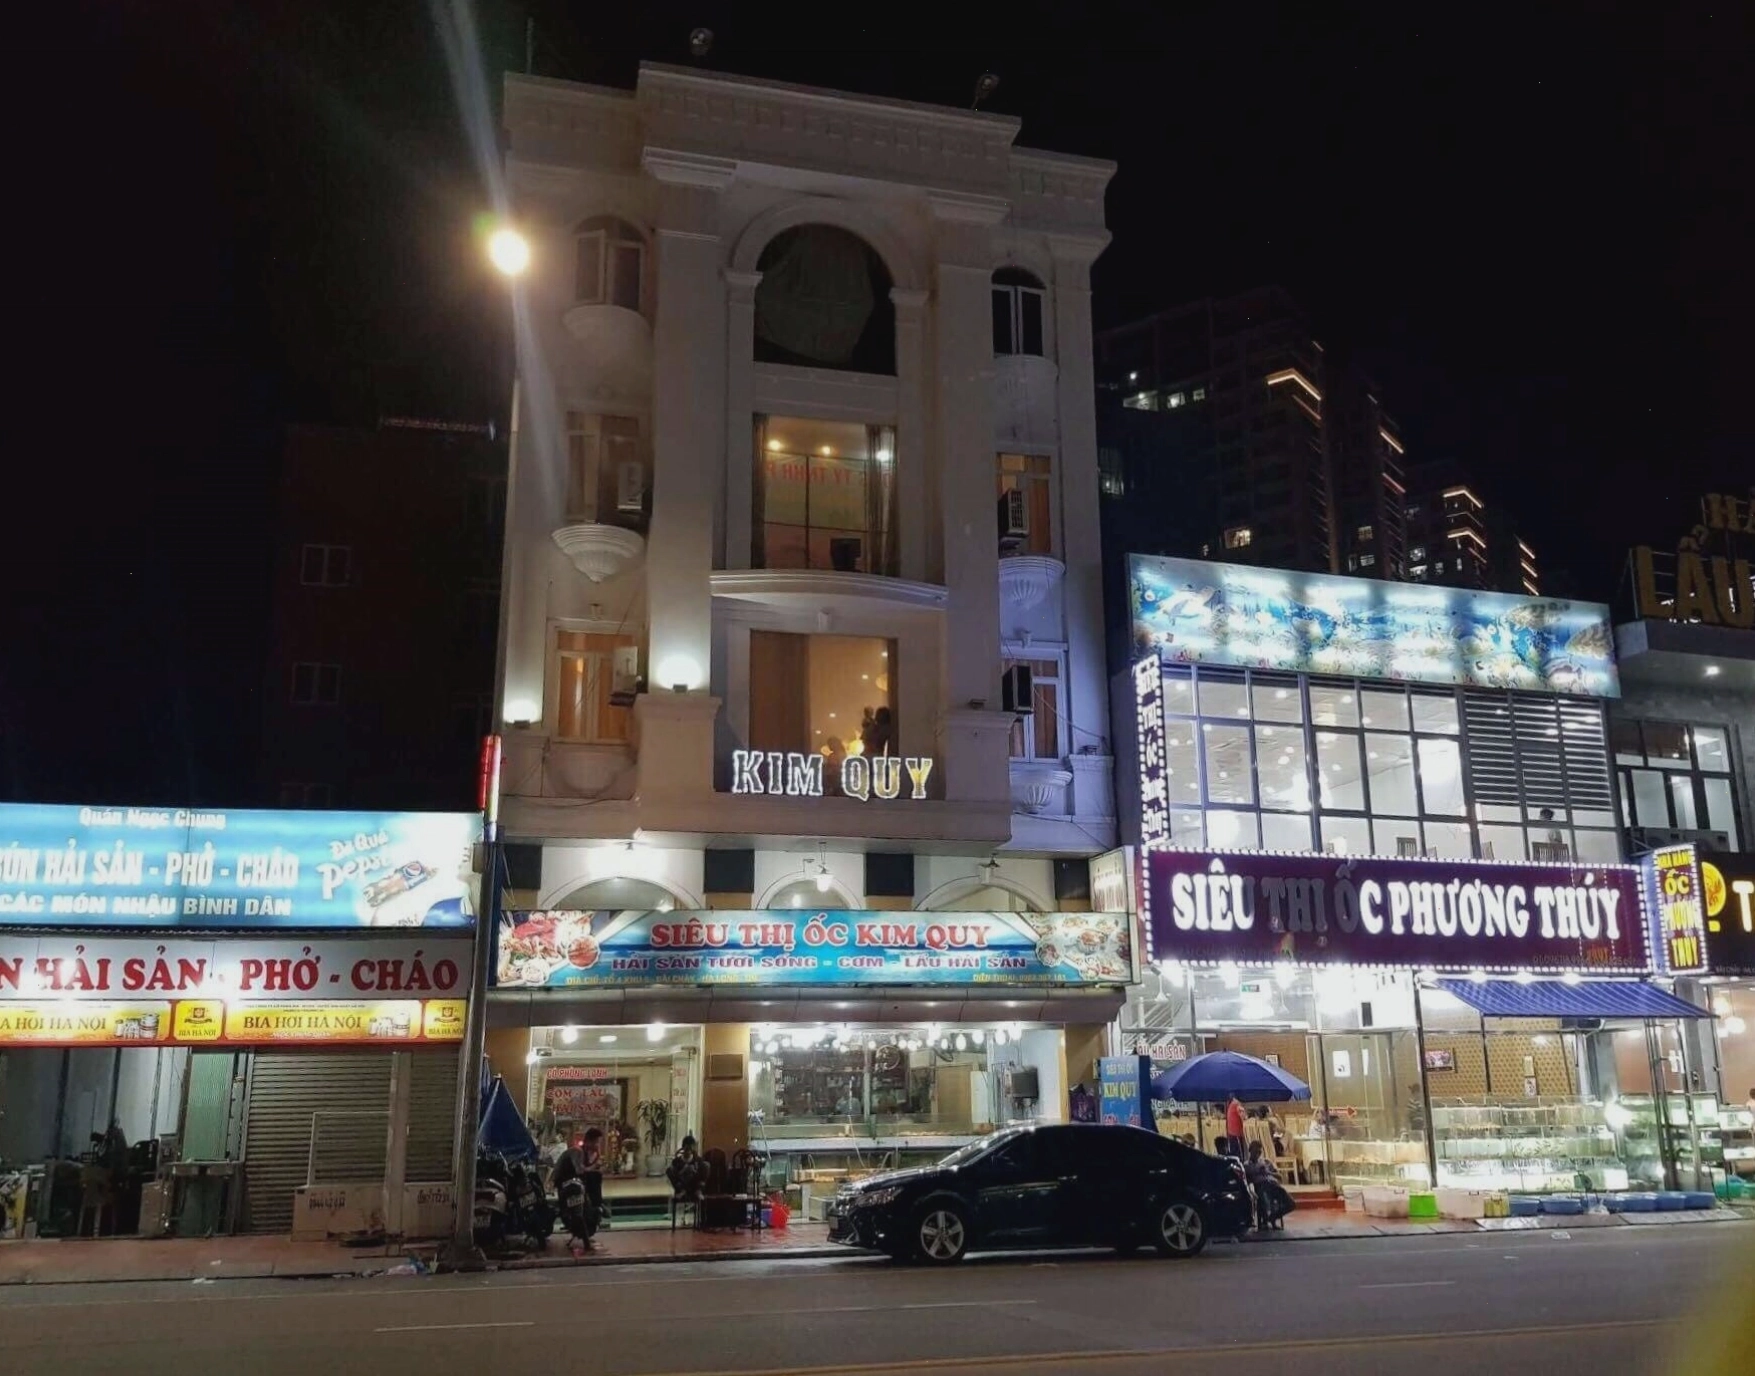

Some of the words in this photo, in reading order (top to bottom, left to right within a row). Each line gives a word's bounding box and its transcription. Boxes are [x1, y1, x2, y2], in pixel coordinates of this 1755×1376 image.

[732, 750, 823, 796] KIM
[80, 807, 123, 827] Quán
[174, 810, 226, 831] Chung
[44, 838, 86, 885] HẢI
[92, 839, 145, 886] SẢN
[164, 841, 217, 887] PHỞ
[236, 847, 299, 887] CHÁO
[1664, 869, 1690, 896] ỐC
[51, 893, 107, 914] MÓN
[113, 893, 176, 918] NHẬU
[183, 894, 237, 915] BÌNH
[244, 895, 292, 917] DÂN
[1171, 858, 1255, 931] SIÊU
[1261, 876, 1328, 947] THỊ
[1334, 858, 1384, 934] ỐC
[1387, 878, 1530, 938] PHƯƠNG
[1534, 872, 1620, 939] THÚY
[651, 917, 729, 947] SIÊU
[738, 921, 795, 951] THỊ
[804, 912, 848, 946] ỐC
[857, 922, 917, 947] KIM
[925, 923, 992, 950] QUY
[35, 944, 112, 991] HẢI
[122, 944, 207, 991] SẢN
[239, 946, 321, 991] PHỞ
[351, 950, 459, 991] CHÁO
[612, 952, 649, 970] HẢI
[656, 953, 701, 970] SẢN
[708, 955, 755, 970] TƯƠI
[762, 952, 818, 968] SỐNG
[838, 955, 884, 968] CƠM
[987, 953, 1027, 968] SẢN
[244, 1016, 271, 1029] BIA
[334, 1014, 362, 1030] NỘI
